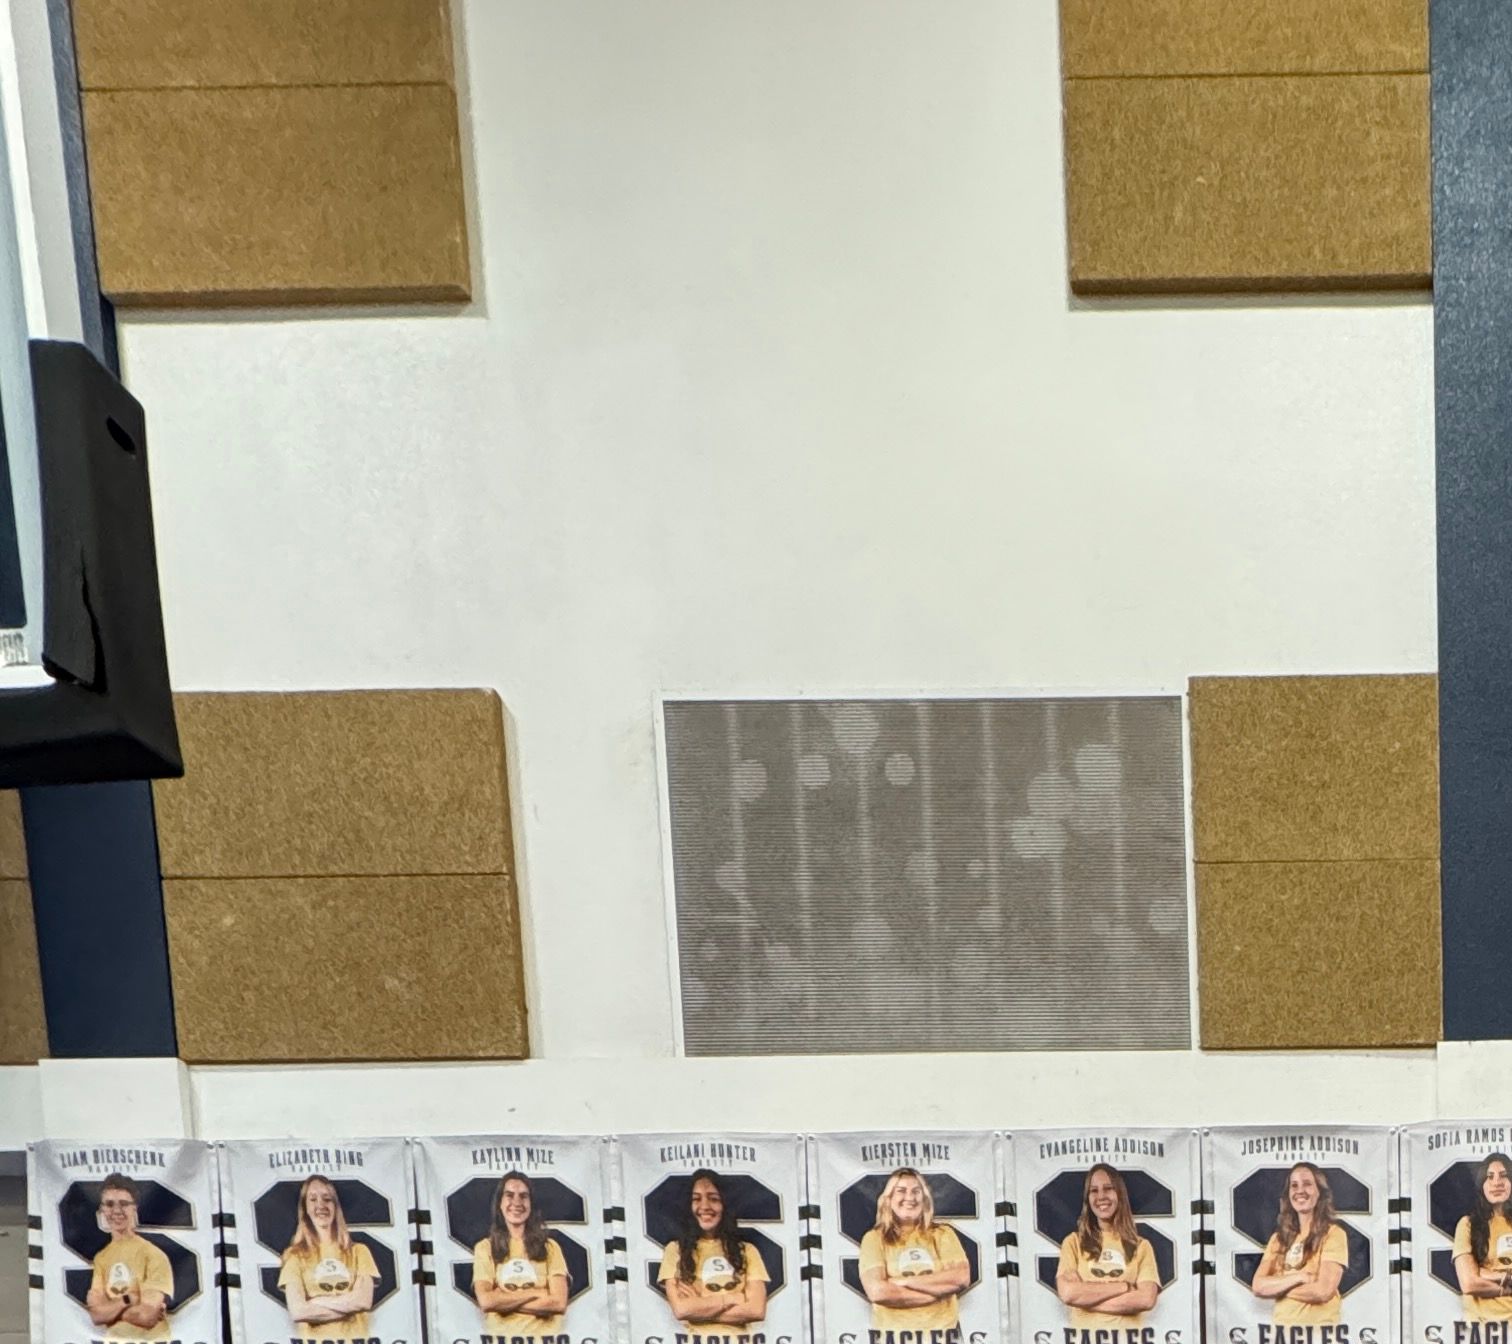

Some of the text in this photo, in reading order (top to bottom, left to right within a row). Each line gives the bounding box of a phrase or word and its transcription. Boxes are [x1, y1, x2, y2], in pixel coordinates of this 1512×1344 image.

[1428, 1131, 1461, 1150] SOFIA
[1466, 1128, 1504, 1144] RAMOS
[922, 1143, 950, 1161] MIZE
